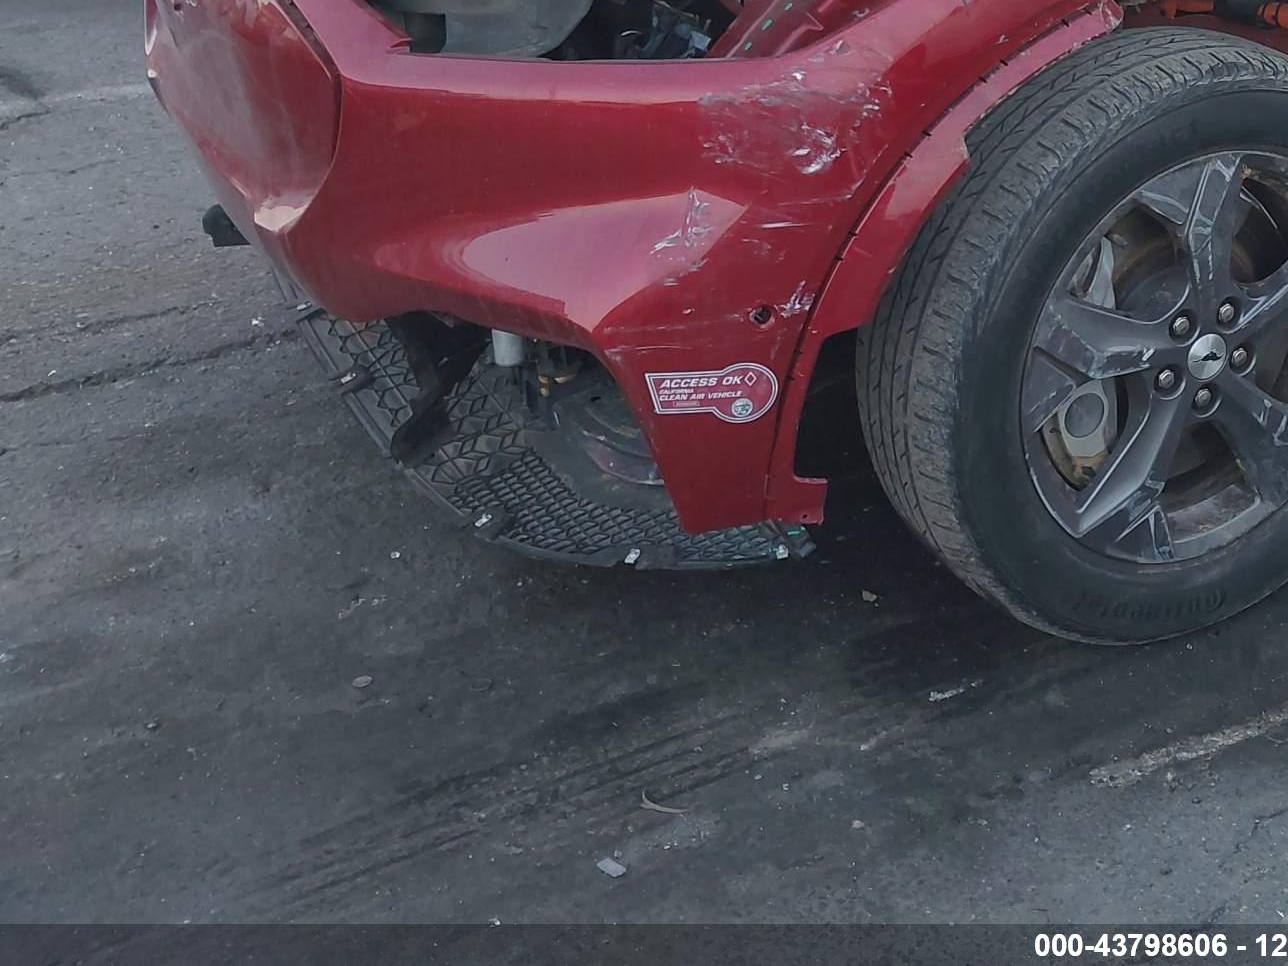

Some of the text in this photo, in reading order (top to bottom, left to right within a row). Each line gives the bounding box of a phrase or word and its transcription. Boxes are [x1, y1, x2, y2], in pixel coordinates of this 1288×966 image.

[659, 375, 744, 388] ACCESS OK
[659, 390, 743, 402] CLEAN AIR VEHICLE
